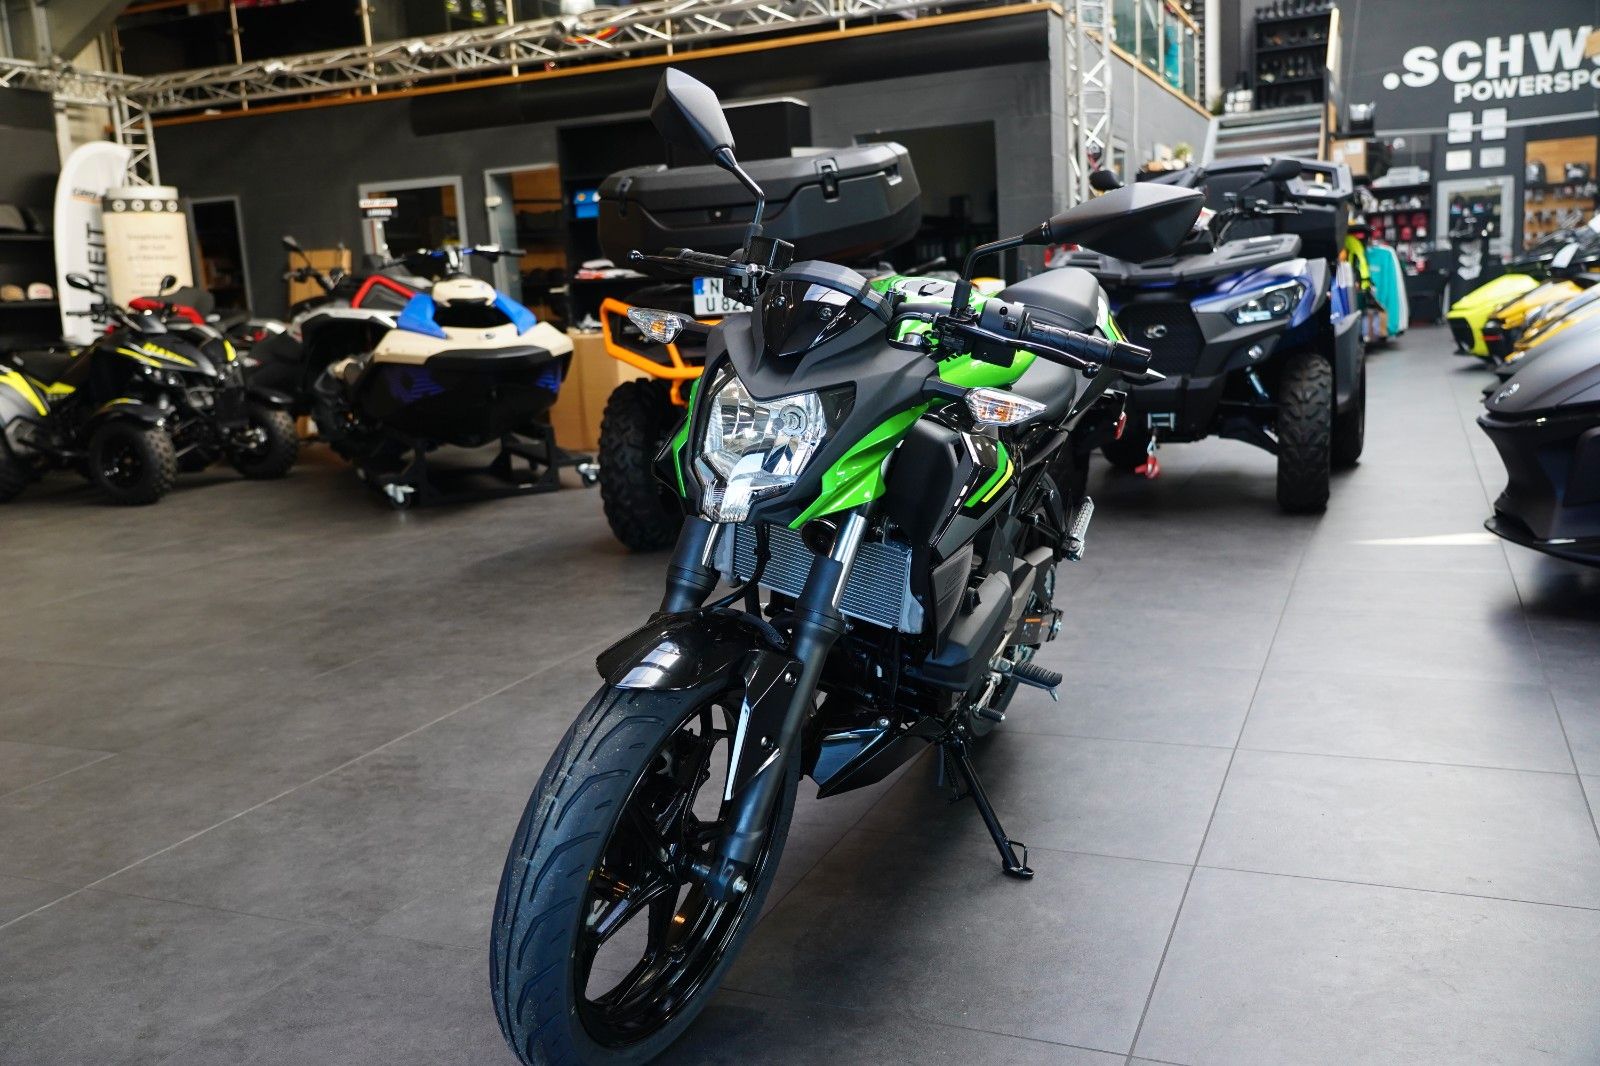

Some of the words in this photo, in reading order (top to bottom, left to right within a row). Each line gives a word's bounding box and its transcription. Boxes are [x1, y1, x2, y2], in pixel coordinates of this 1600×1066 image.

[1382, 25, 1600, 90] .SCHW
[705, 297, 715, 312] U
[722, 297, 747, 312] 82
